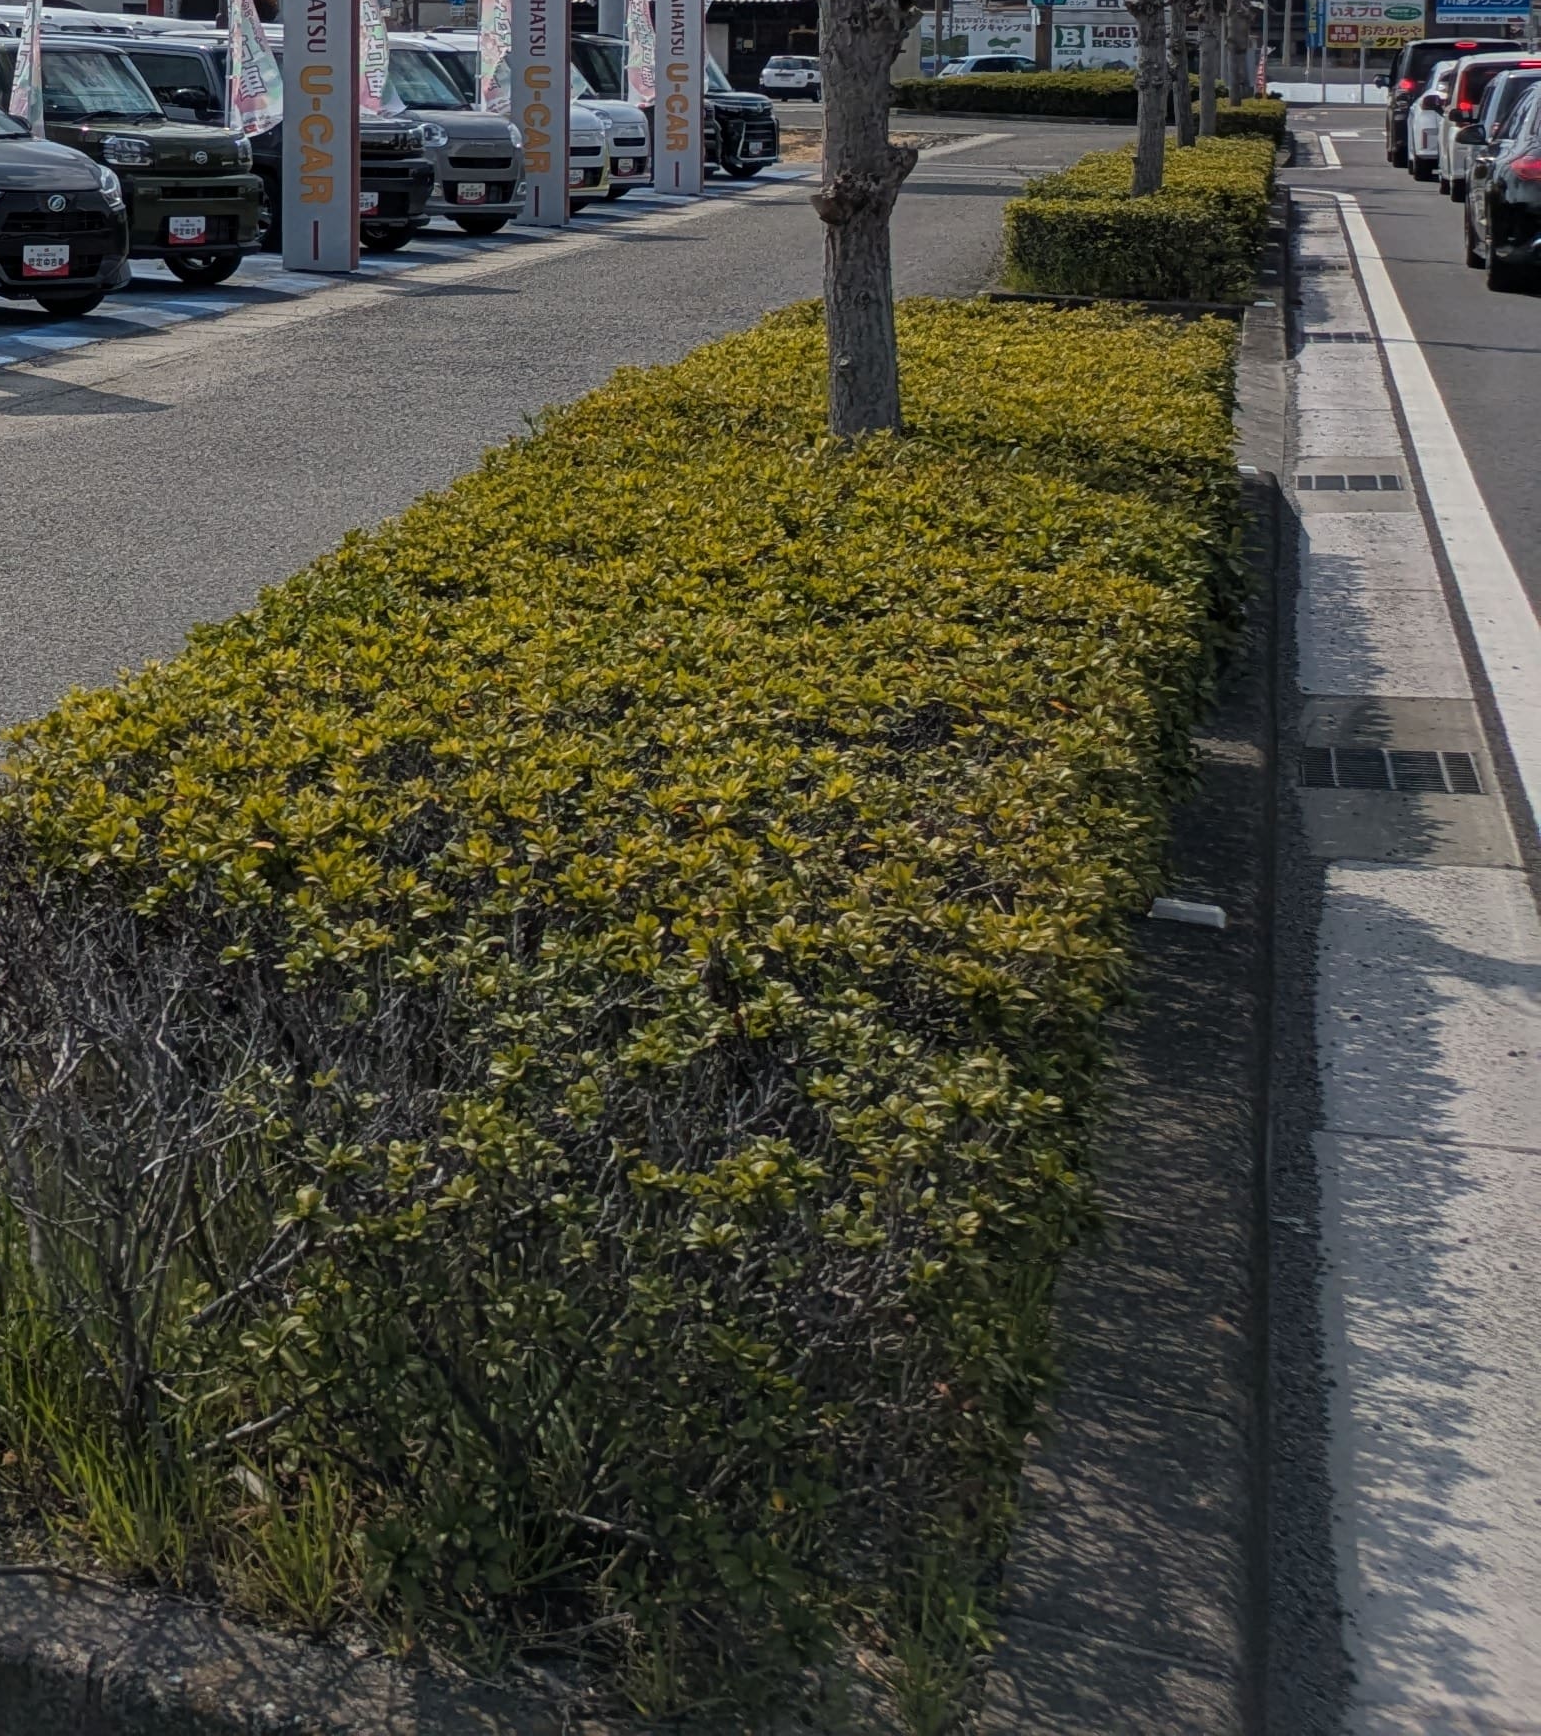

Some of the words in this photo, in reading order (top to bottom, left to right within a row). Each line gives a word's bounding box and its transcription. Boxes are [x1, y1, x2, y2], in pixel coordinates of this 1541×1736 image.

[1059, 28, 1081, 46] B
[1091, 39, 1132, 48] BESS
[299, 65, 334, 204] U-CAR
[523, 65, 551, 174] U-CAR
[665, 63, 690, 151] U-CAR
